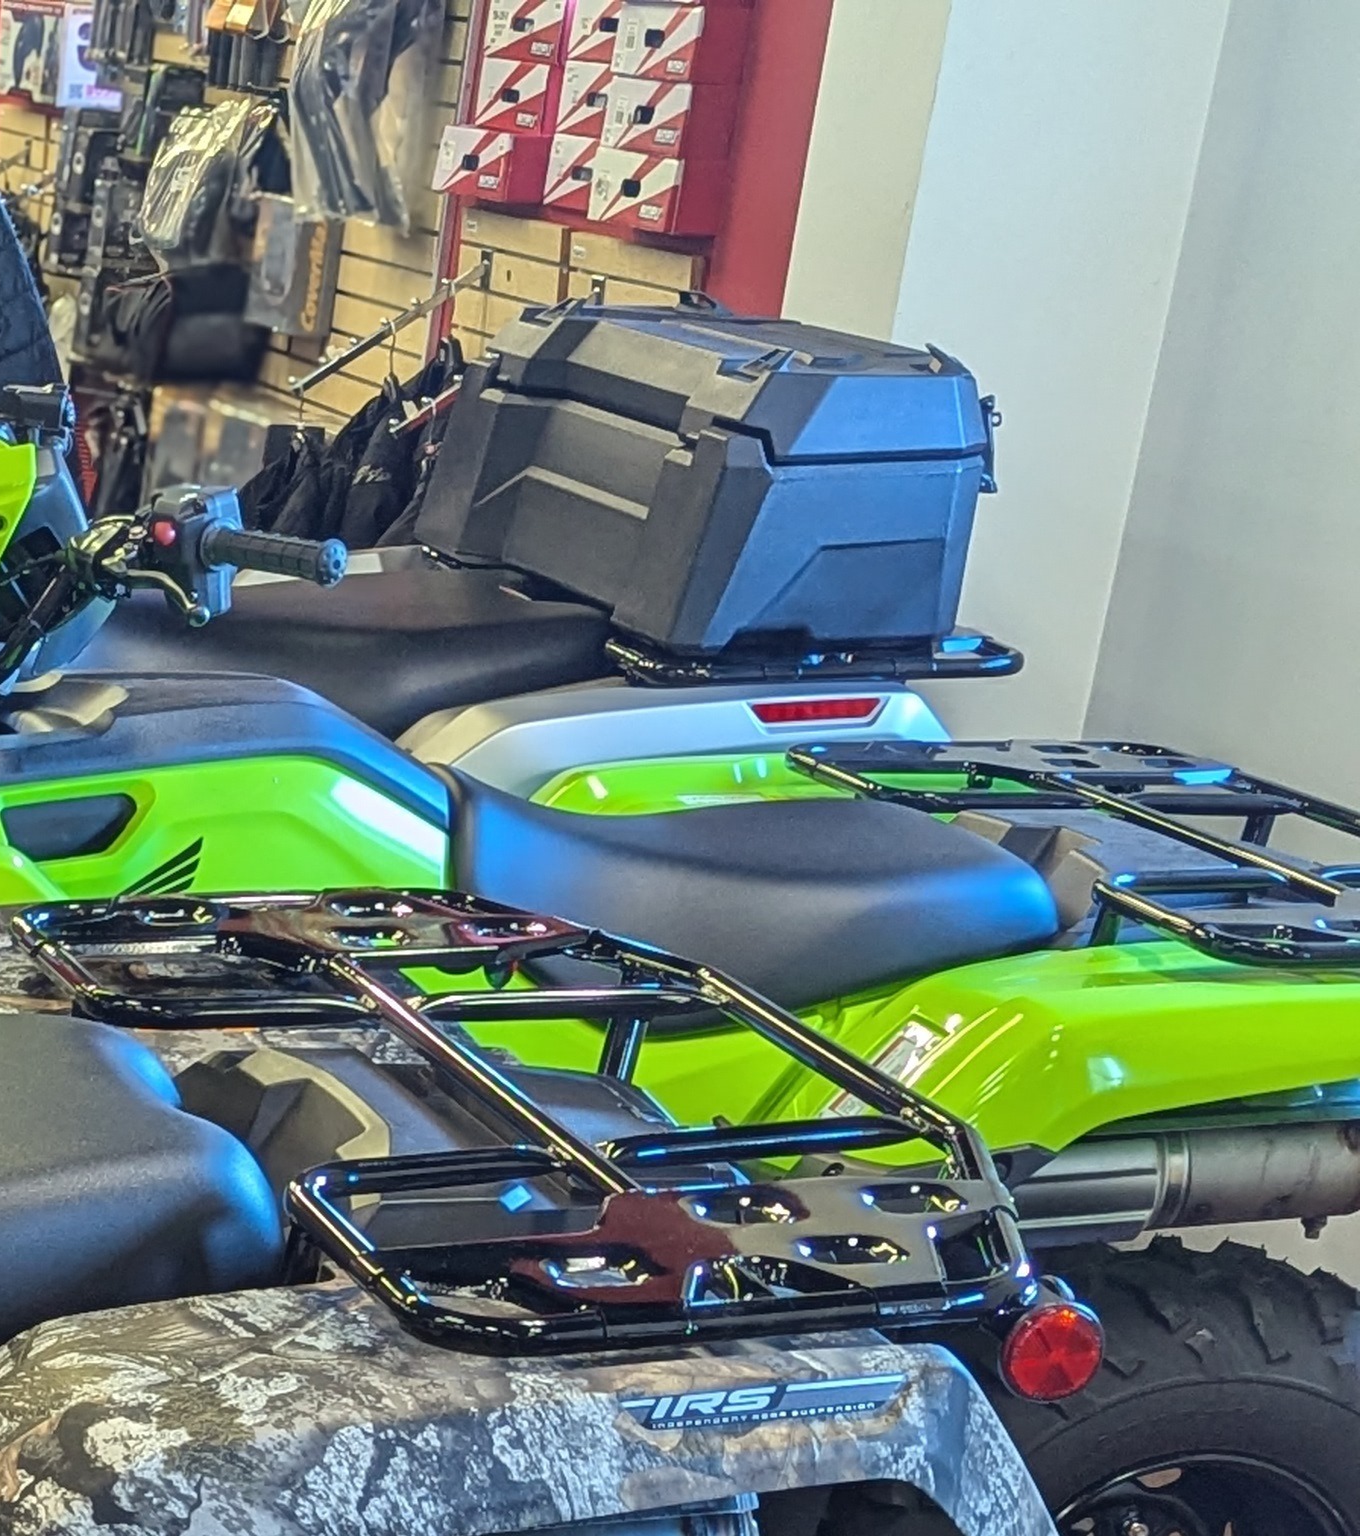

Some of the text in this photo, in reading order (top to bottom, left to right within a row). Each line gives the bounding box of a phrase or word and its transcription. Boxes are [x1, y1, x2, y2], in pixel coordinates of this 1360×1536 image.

[651, 1386, 777, 1419] IRS
[652, 1415, 748, 1430] INDEPENDENT
[791, 1401, 876, 1418] SUSPENSION
